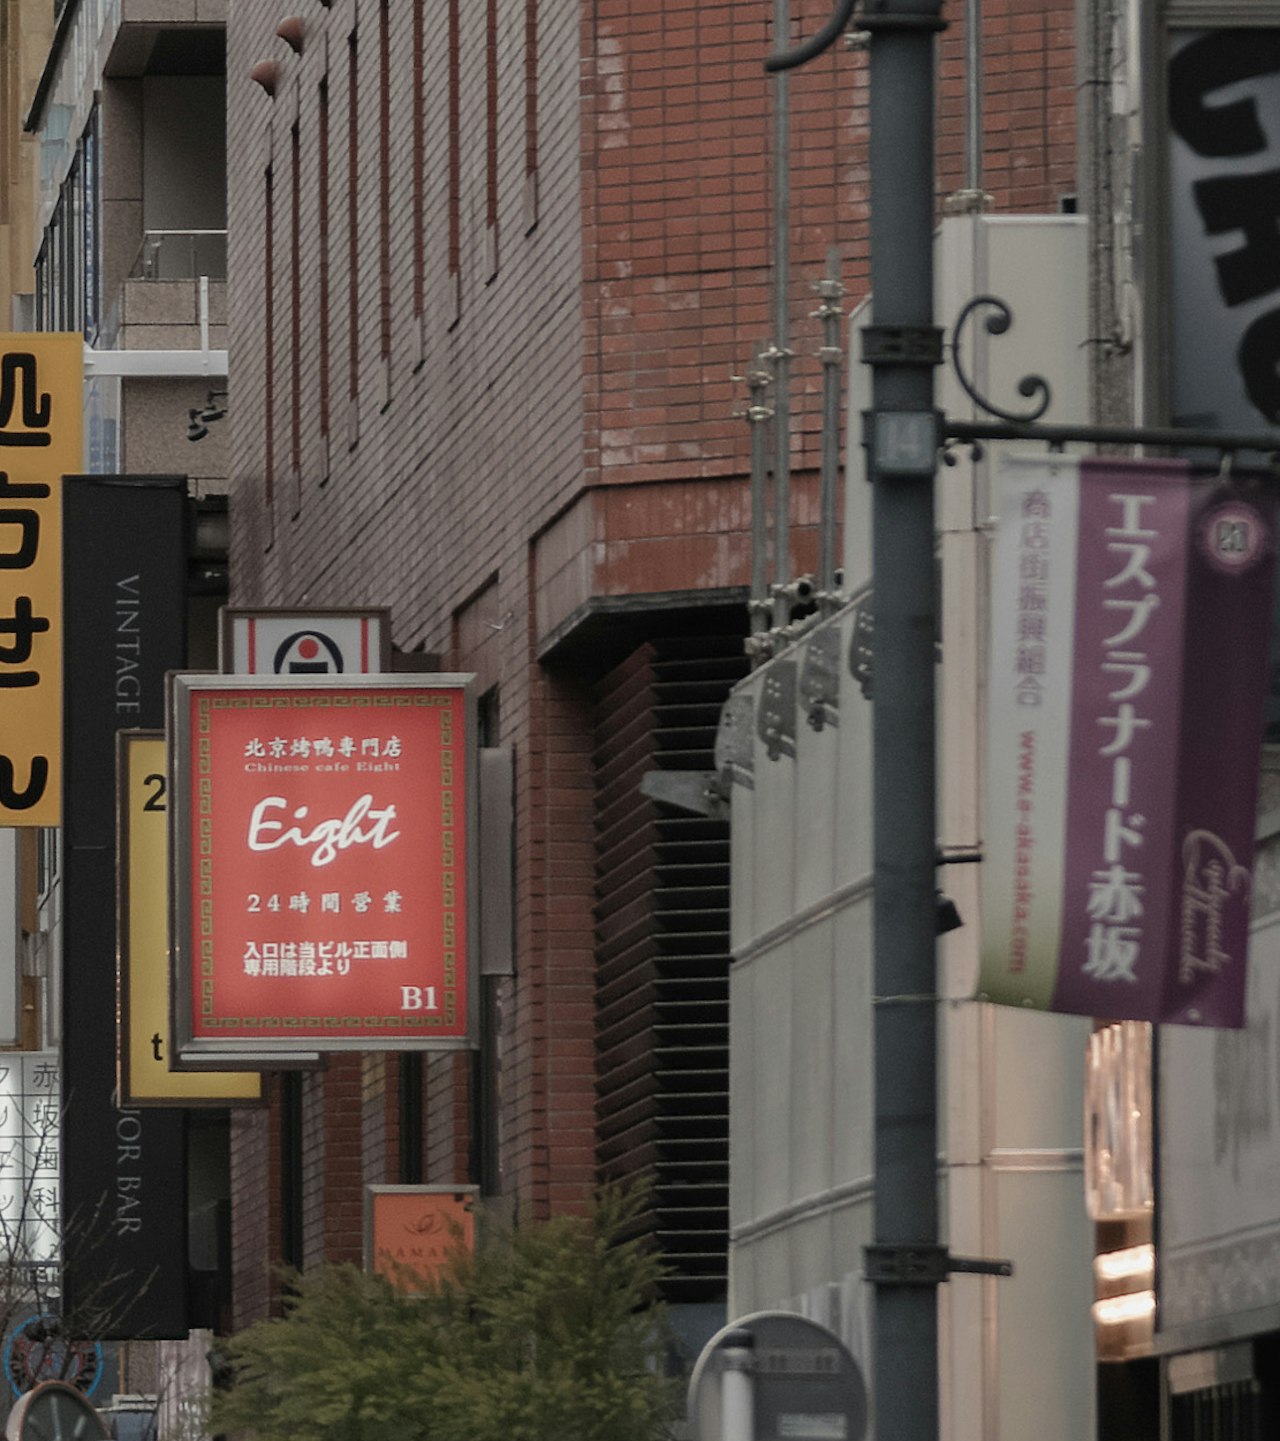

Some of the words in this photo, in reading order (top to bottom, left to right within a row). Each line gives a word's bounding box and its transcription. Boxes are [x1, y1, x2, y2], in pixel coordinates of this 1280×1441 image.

[115, 575, 140, 715] VINTAGE
[244, 735, 402, 758] 北京烤鴨専門店
[1081, 493, 1161, 983] エスプラナード赤坂
[244, 762, 310, 773] Chinese
[315, 762, 351, 773] cafe
[356, 761, 401, 775] Eight
[247, 793, 401, 867] Eight
[246, 890, 403, 913] 24時間営業
[243, 941, 408, 959] 入口は当ビル正面側
[243, 959, 351, 977] 専用階段より
[400, 986, 439, 1010] B1
[116, 1176, 143, 1237] BAR
